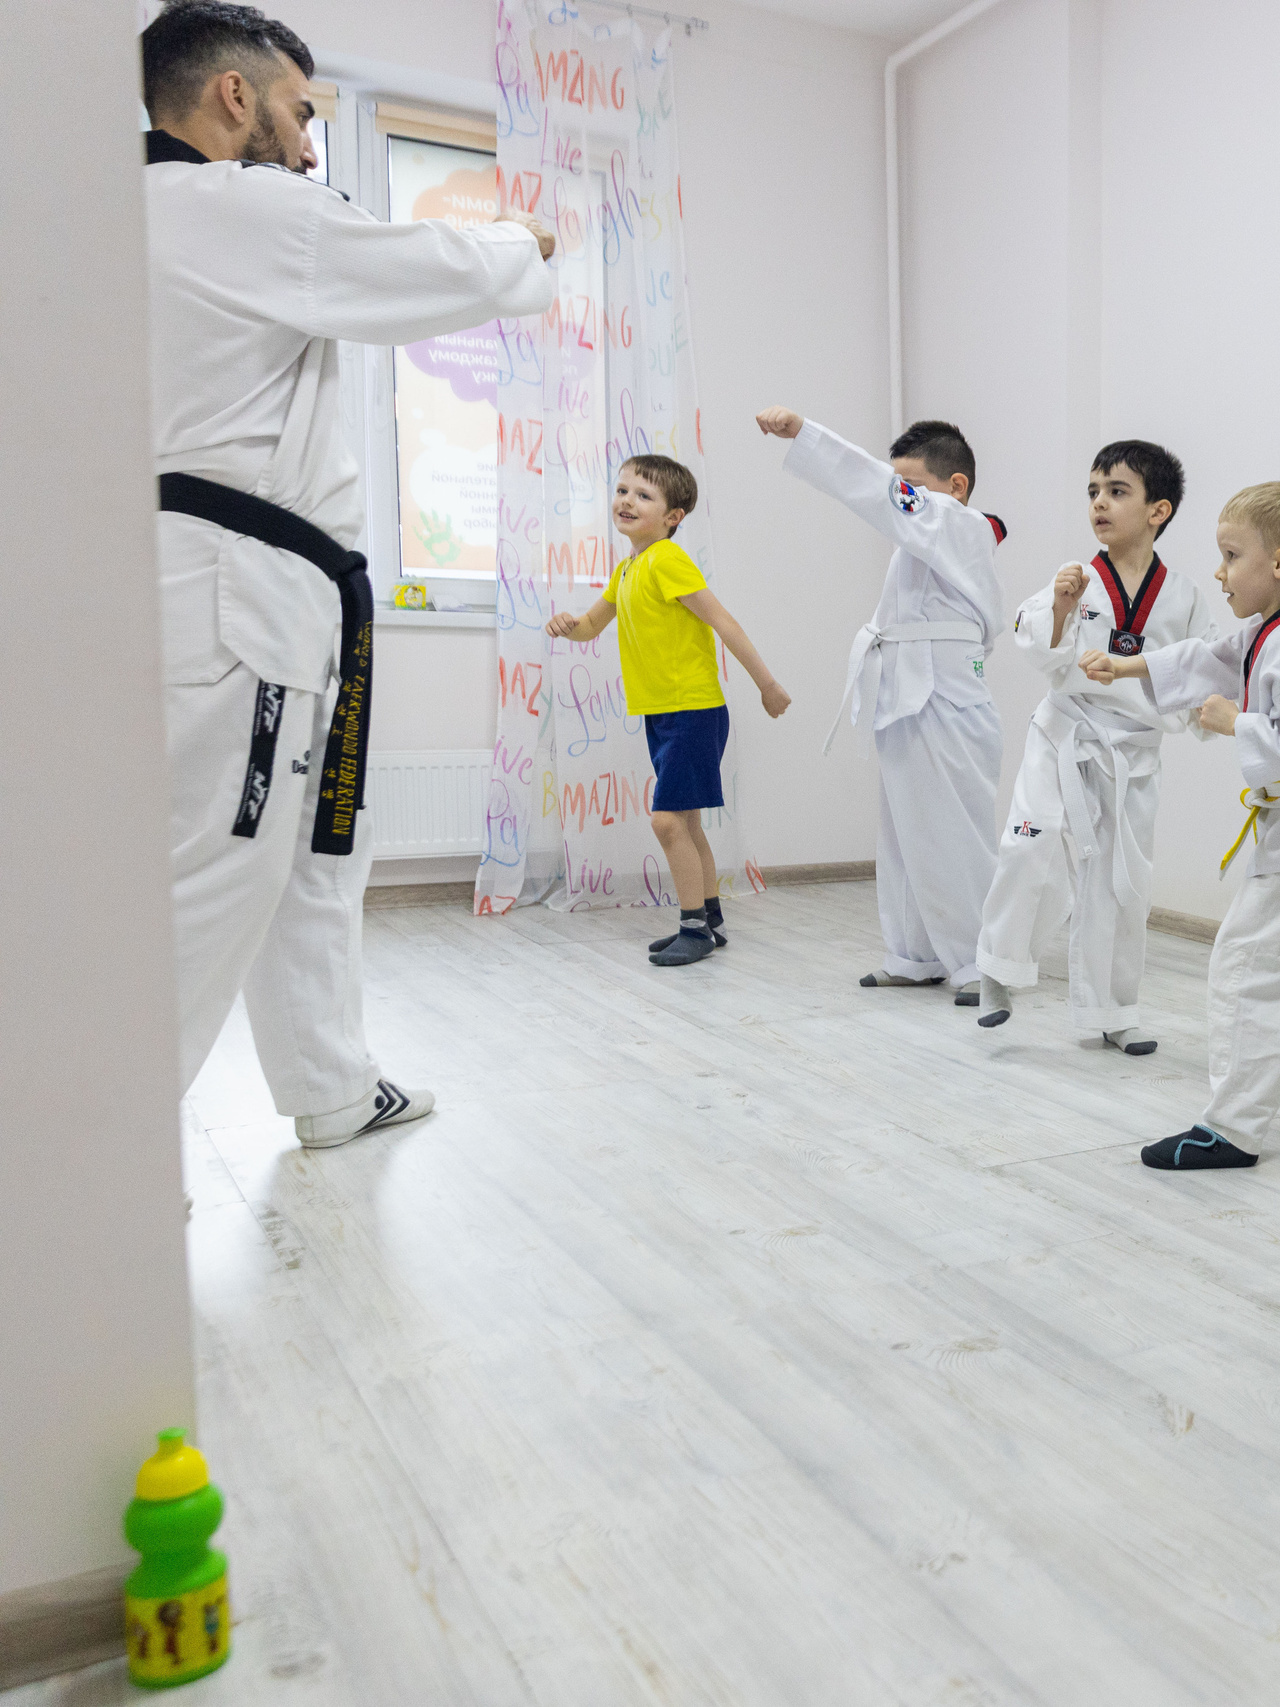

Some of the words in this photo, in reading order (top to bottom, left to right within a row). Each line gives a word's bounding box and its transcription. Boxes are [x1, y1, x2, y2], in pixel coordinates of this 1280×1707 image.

[343, 674, 366, 755] TAEKWONDO
[332, 757, 357, 835] FEDERATION
[565, 839, 615, 895] Live
